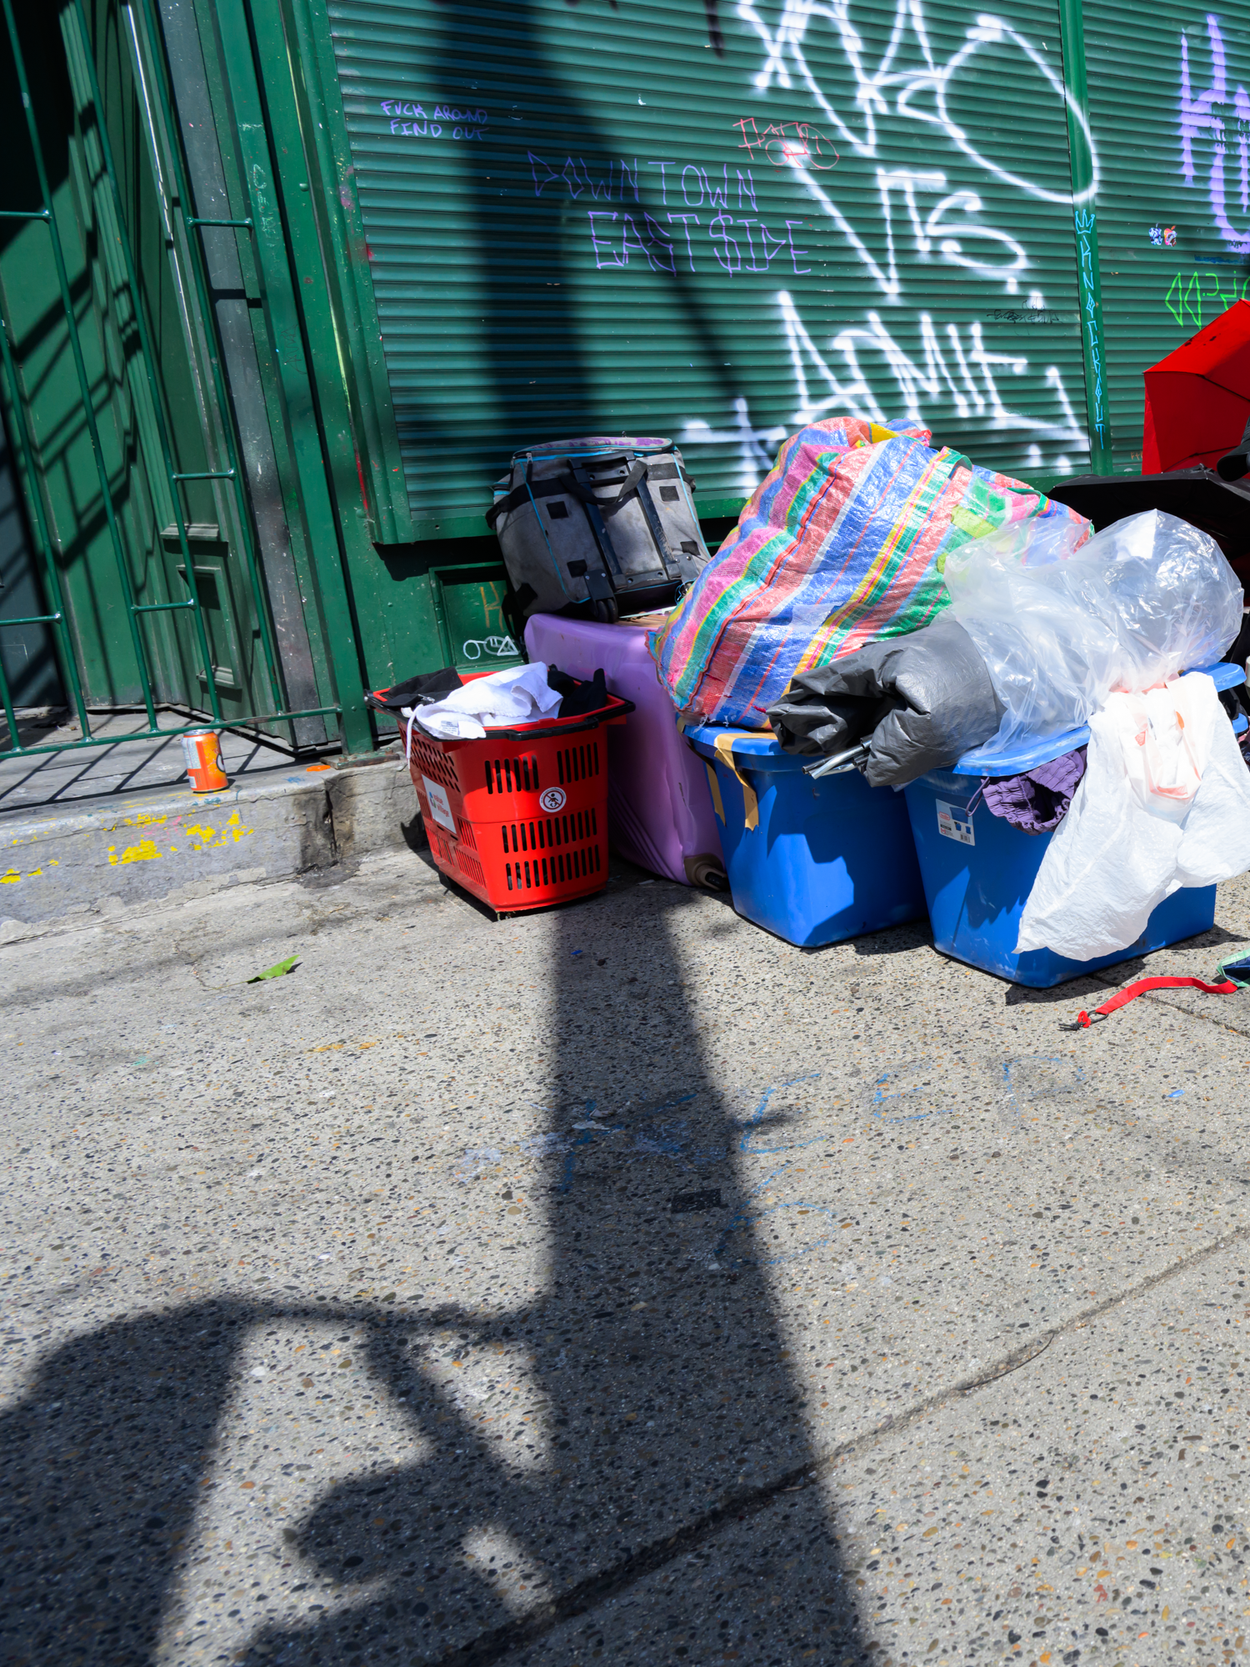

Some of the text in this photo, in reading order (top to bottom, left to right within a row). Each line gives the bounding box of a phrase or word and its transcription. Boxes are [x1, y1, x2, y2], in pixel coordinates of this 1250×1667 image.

[433, 104, 488, 125] AROUND
[390, 118, 489, 140] FIND OUT
